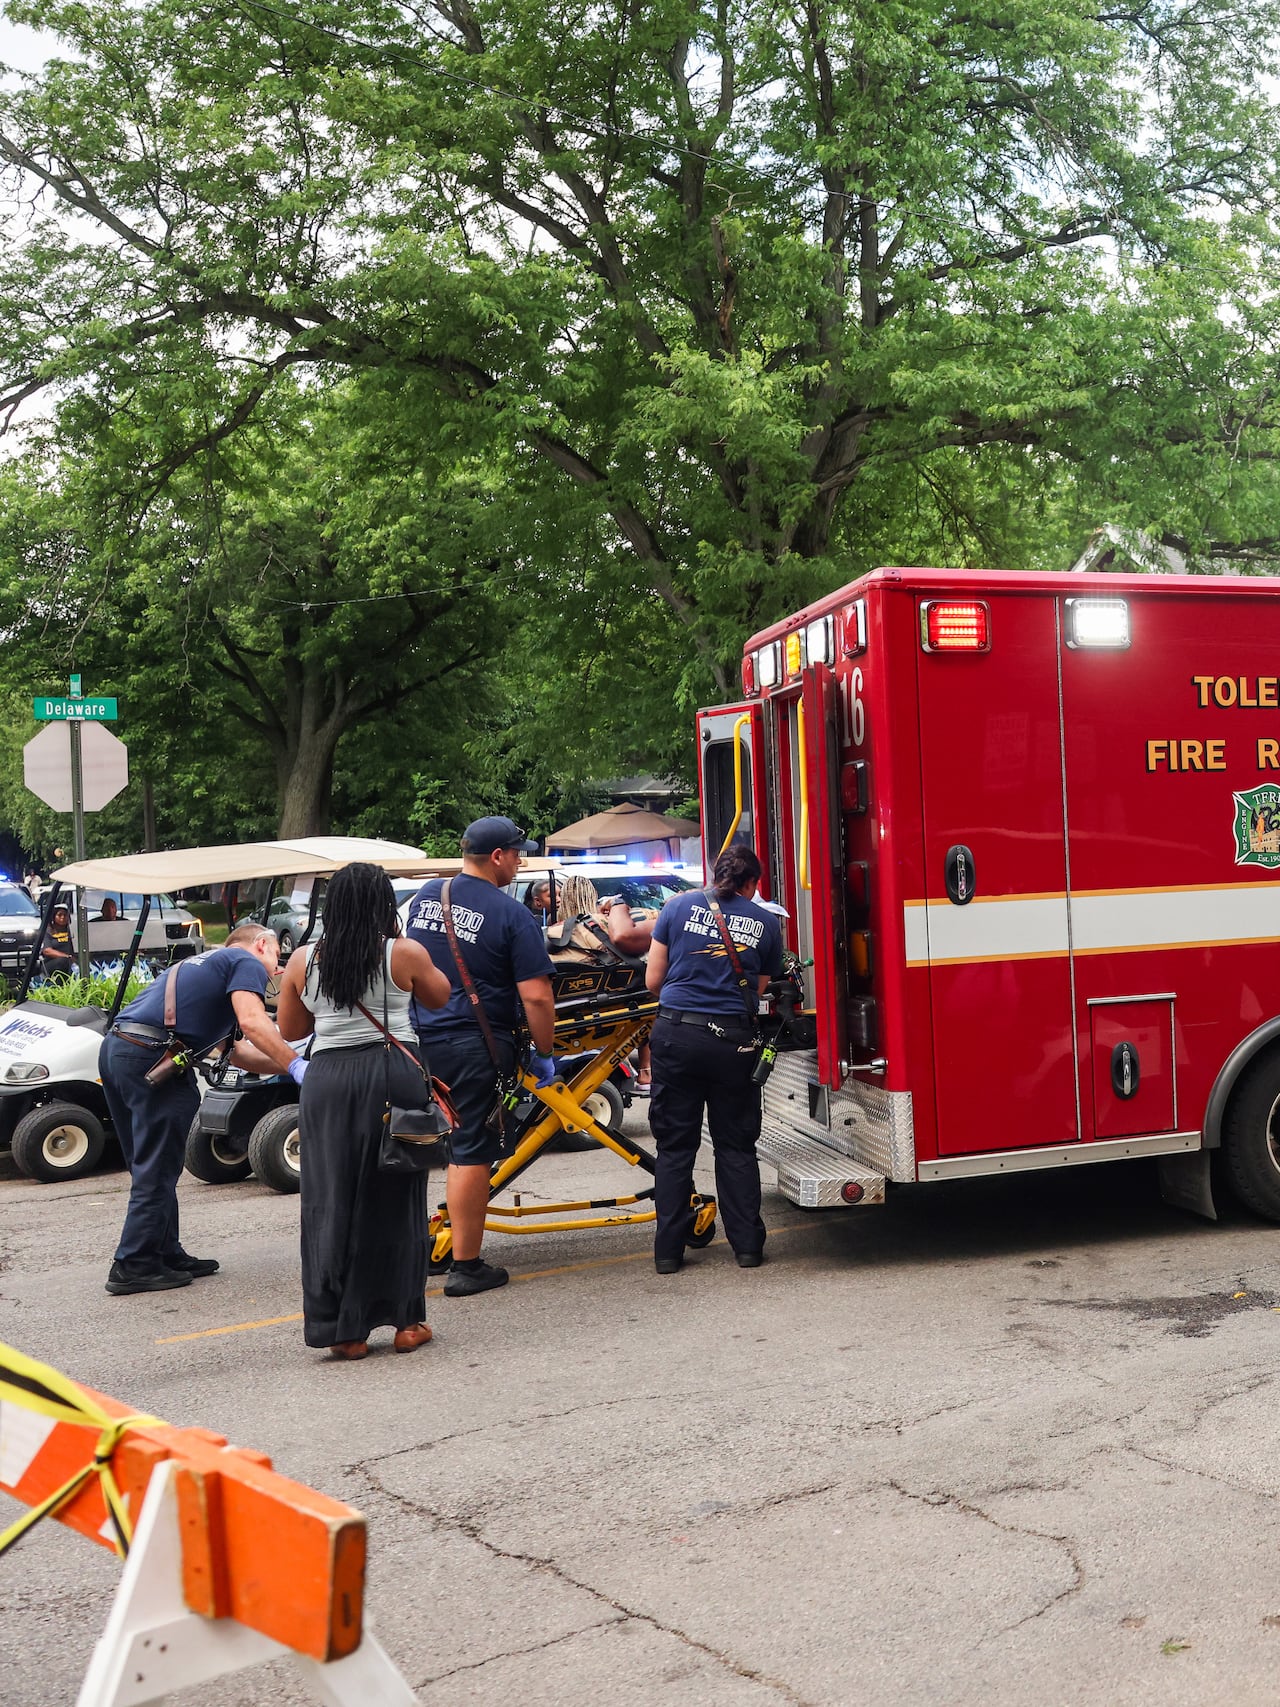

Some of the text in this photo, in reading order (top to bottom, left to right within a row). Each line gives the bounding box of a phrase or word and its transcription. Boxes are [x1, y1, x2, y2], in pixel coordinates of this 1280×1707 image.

[45, 701, 106, 716] Delaware
[840, 666, 865, 748] 16
[1146, 738, 1227, 773] FIRE
[429, 921, 439, 932] &
[683, 921, 709, 937] FIRE
[709, 929, 720, 939] &
[690, 904, 765, 939] TOEDO
[569, 979, 594, 990] XPS
[0, 1018, 55, 1038] Welch's
